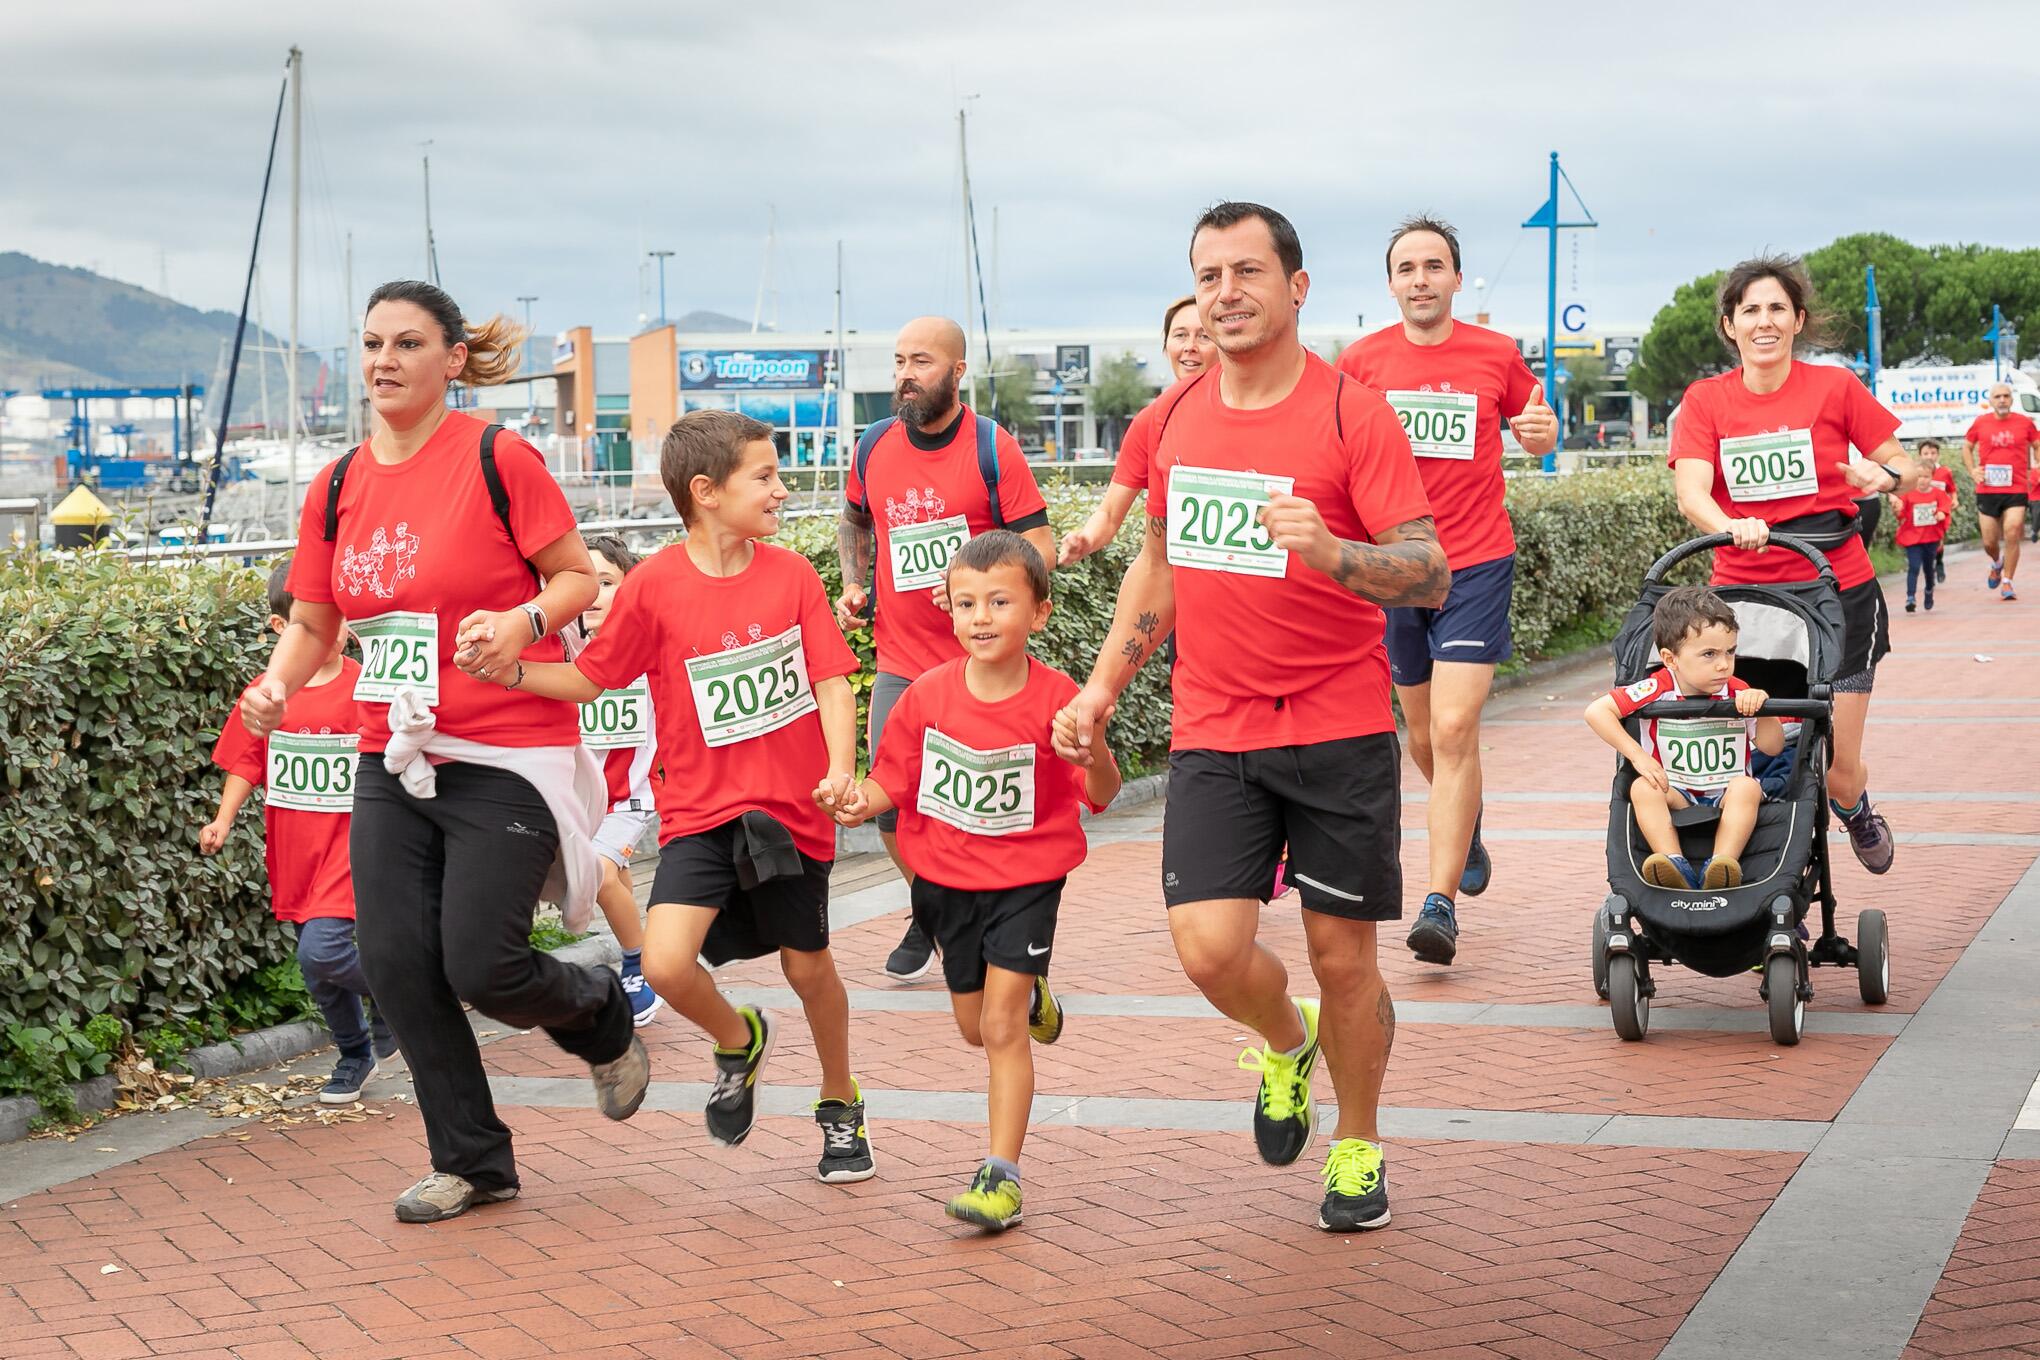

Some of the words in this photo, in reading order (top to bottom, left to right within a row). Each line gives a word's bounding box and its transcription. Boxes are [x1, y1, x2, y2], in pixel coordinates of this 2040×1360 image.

[1563, 304, 1586, 332] C
[716, 357, 808, 381] Tarpoon
[1397, 410, 1466, 442] 2005
[1732, 449, 1805, 485] 2005
[1180, 496, 1274, 551] 2025
[364, 638, 428, 682] 2025
[707, 655, 799, 722] 2025
[582, 698, 638, 732] 005
[274, 753, 351, 793] 2003
[1668, 736, 1737, 774] 2005
[933, 759, 1021, 813] 2025
[1671, 900, 1691, 909] city
[1692, 899, 1715, 908] mini
